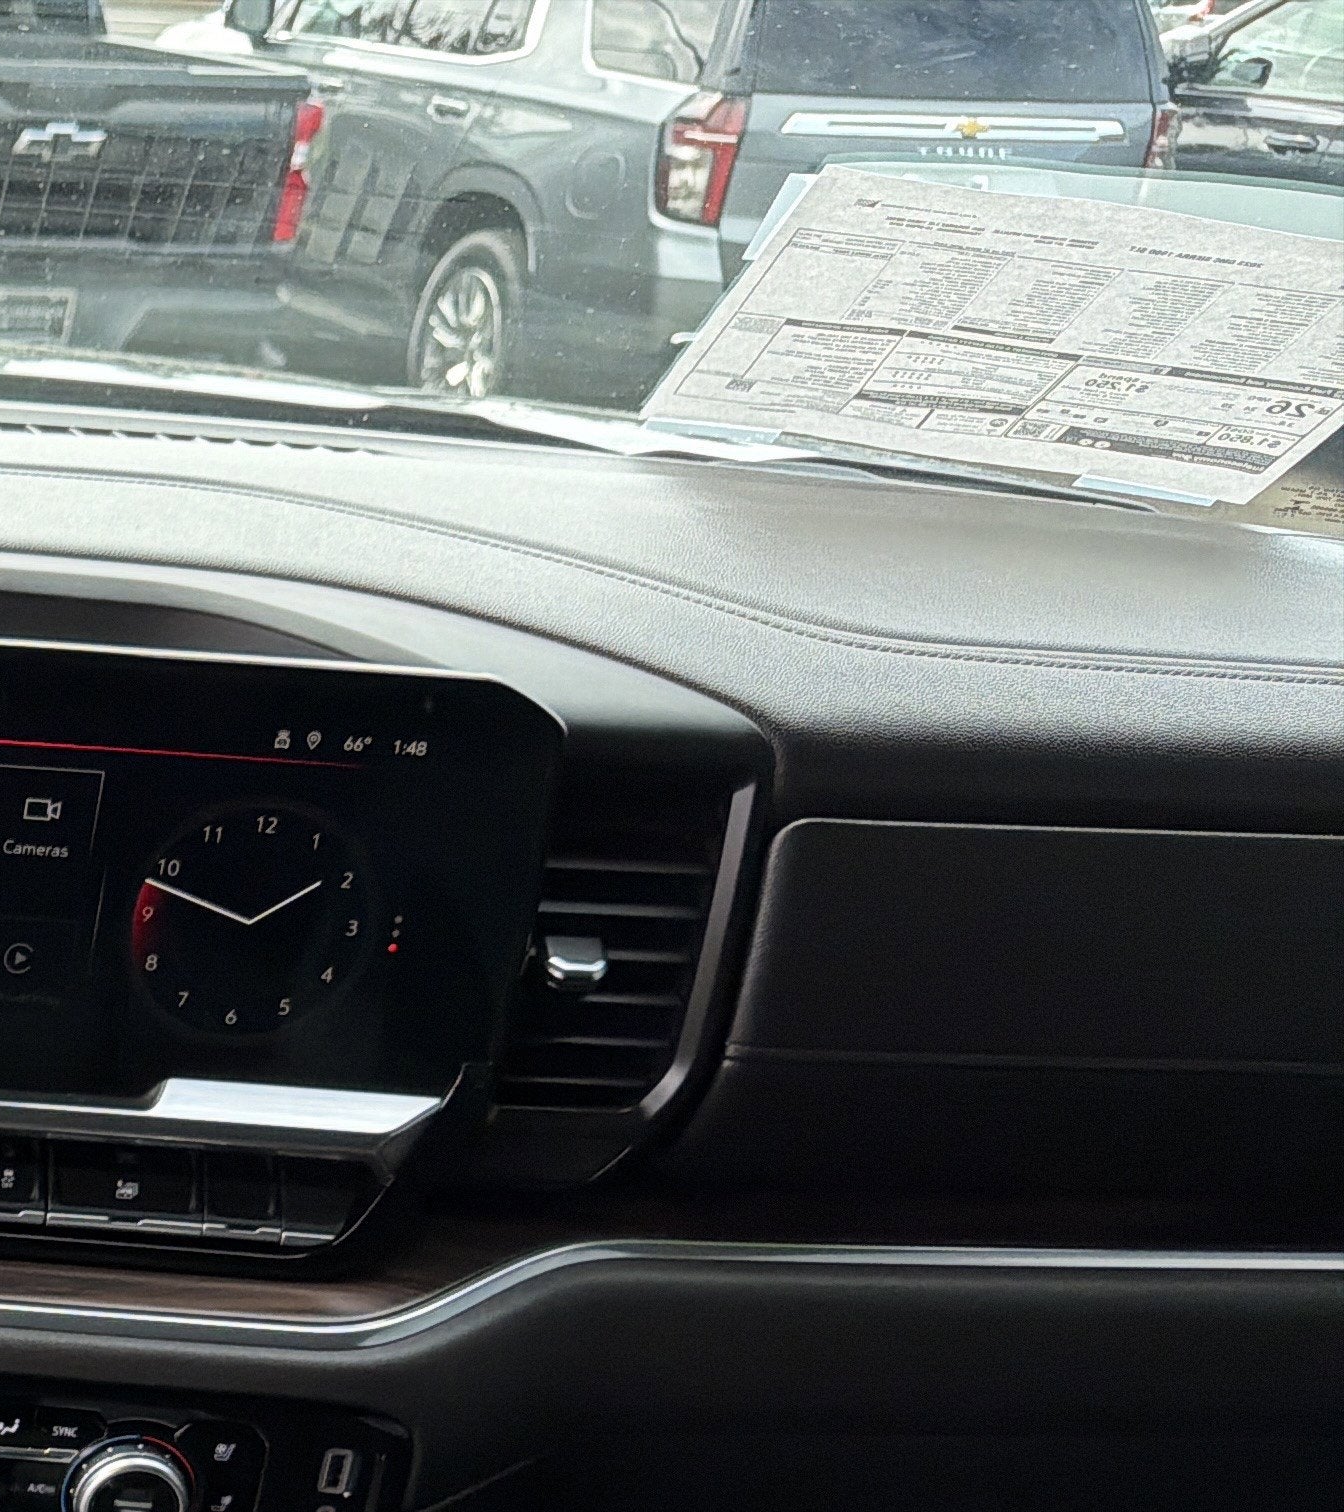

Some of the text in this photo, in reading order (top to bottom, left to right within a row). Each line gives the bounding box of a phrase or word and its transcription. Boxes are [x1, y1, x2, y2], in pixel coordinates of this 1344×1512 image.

[393, 739, 429, 757] 1:48
[256, 816, 279, 834] 12
[203, 825, 224, 843] 11
[312, 833, 321, 849] 1
[2, 839, 70, 859] Cameras
[157, 858, 180, 877] 10
[341, 872, 353, 889] 2
[142, 905, 154, 922] 9
[345, 919, 358, 936] 3
[145, 954, 158, 971] 8
[320, 966, 333, 983] 4
[178, 991, 189, 1007] 7
[278, 998, 291, 1015] 5
[225, 1008, 238, 1025] 6
[52, 1425, 78, 1438] SYNC
